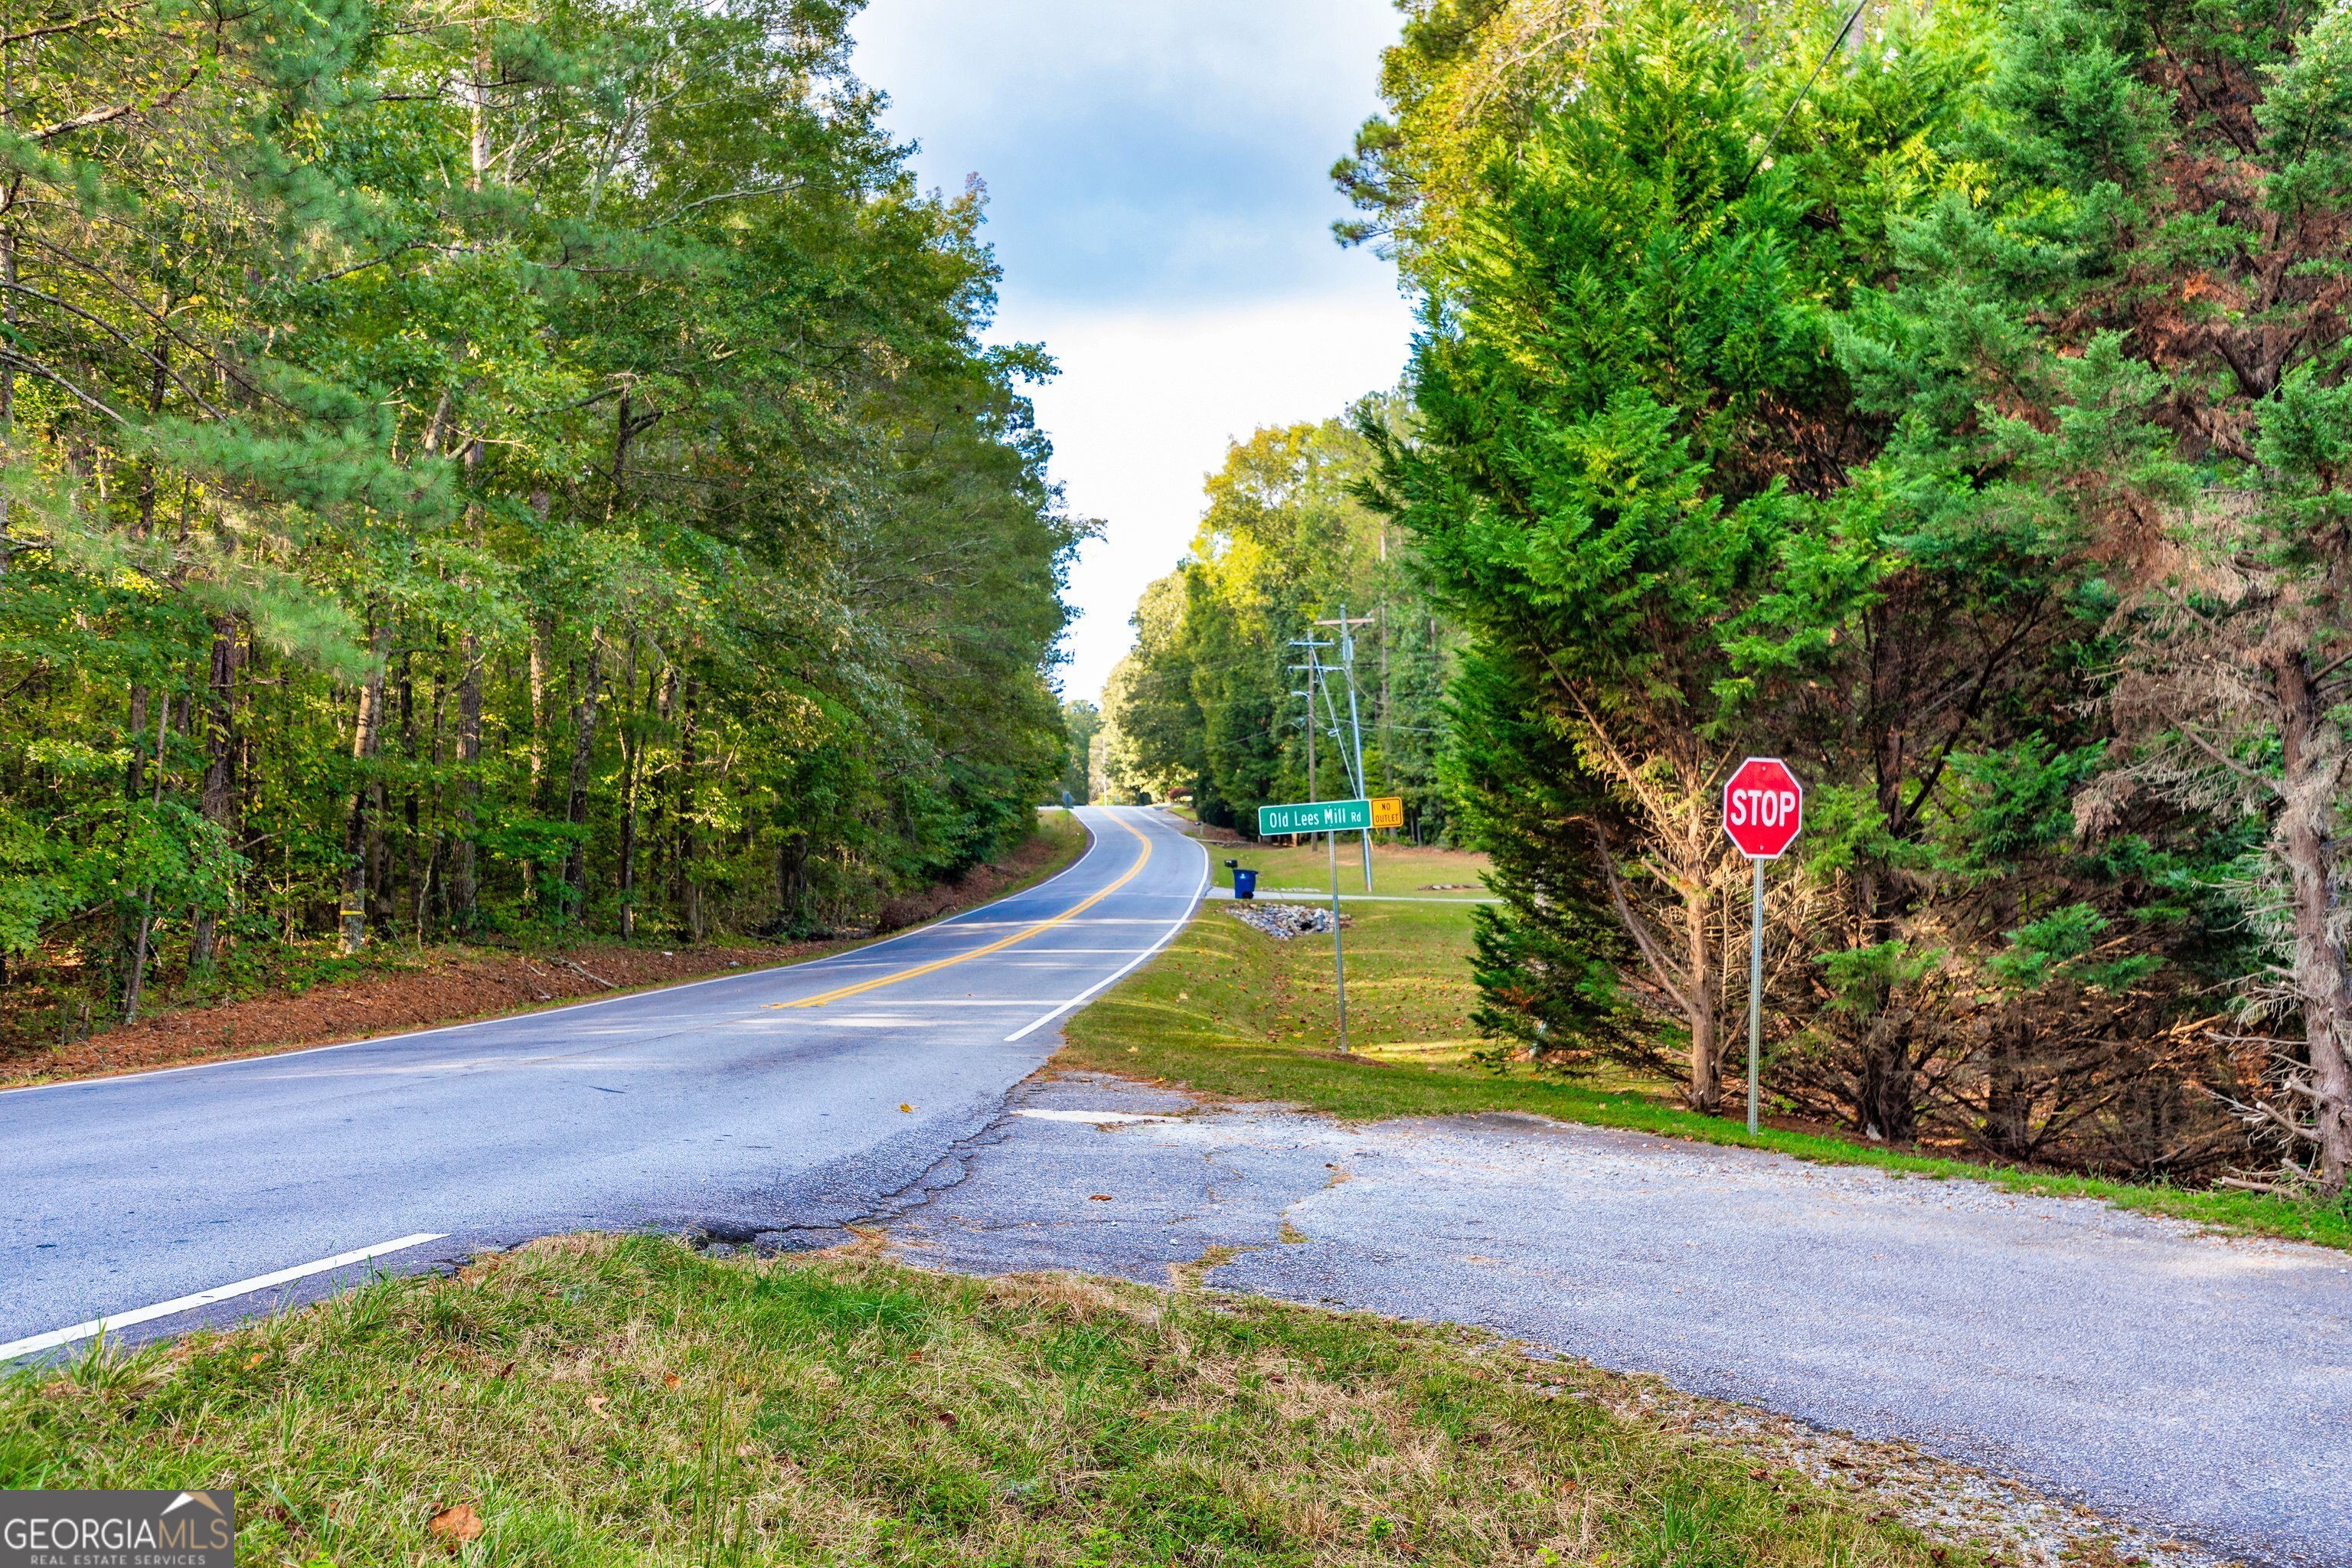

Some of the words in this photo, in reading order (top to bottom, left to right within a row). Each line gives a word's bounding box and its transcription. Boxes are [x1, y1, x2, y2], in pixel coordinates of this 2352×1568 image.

[1381, 802, 1390, 811] NO
[1730, 789, 1795, 827] STOP
[1269, 812, 1289, 828] Old
[1294, 811, 1319, 826] Lees
[1324, 808, 1346, 825] Mill
[1351, 812, 1361, 823] Rd
[1375, 812, 1400, 823] OUTLET
